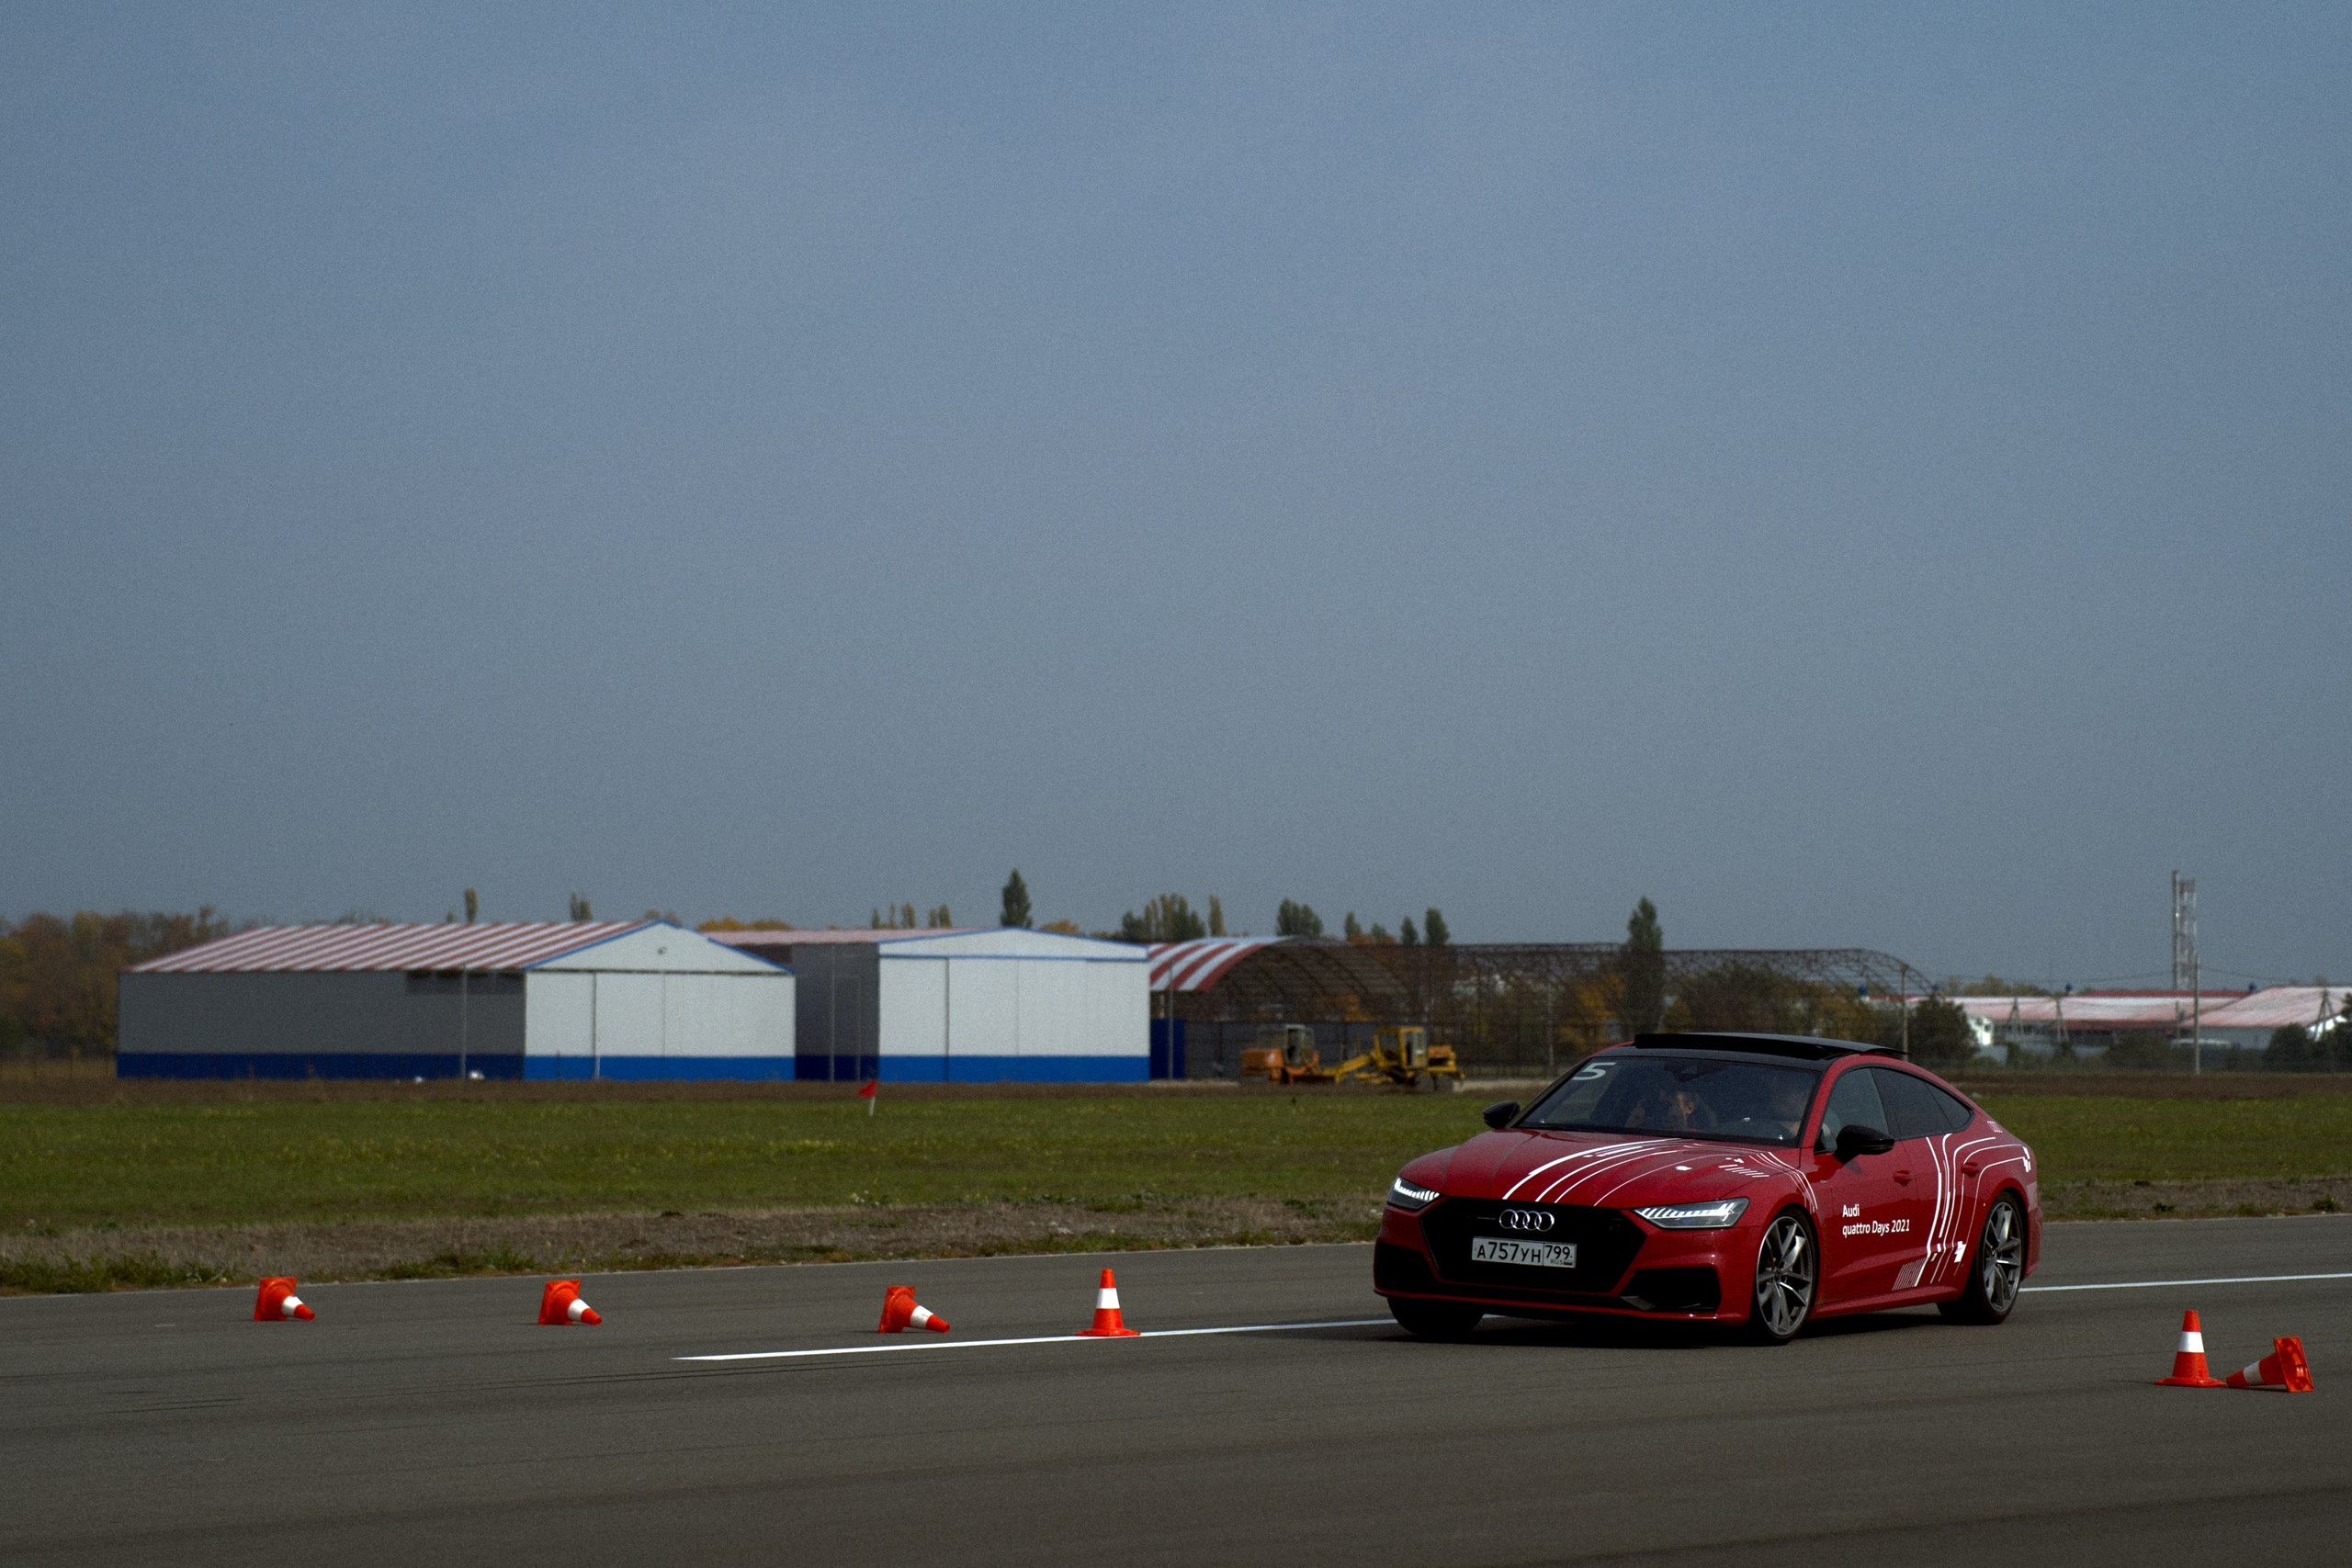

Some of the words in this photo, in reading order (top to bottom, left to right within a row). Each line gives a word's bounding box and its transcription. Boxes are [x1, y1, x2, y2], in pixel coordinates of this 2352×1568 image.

[1571, 1062, 1617, 1081] 5
[1842, 1203, 1860, 1218] Audi
[1842, 1223, 1871, 1238] quattro
[1871, 1220, 1890, 1236] Days
[1891, 1219, 1910, 1233] 2021
[1476, 1241, 1542, 1263] А757УН
[1544, 1245, 1571, 1260] 799
